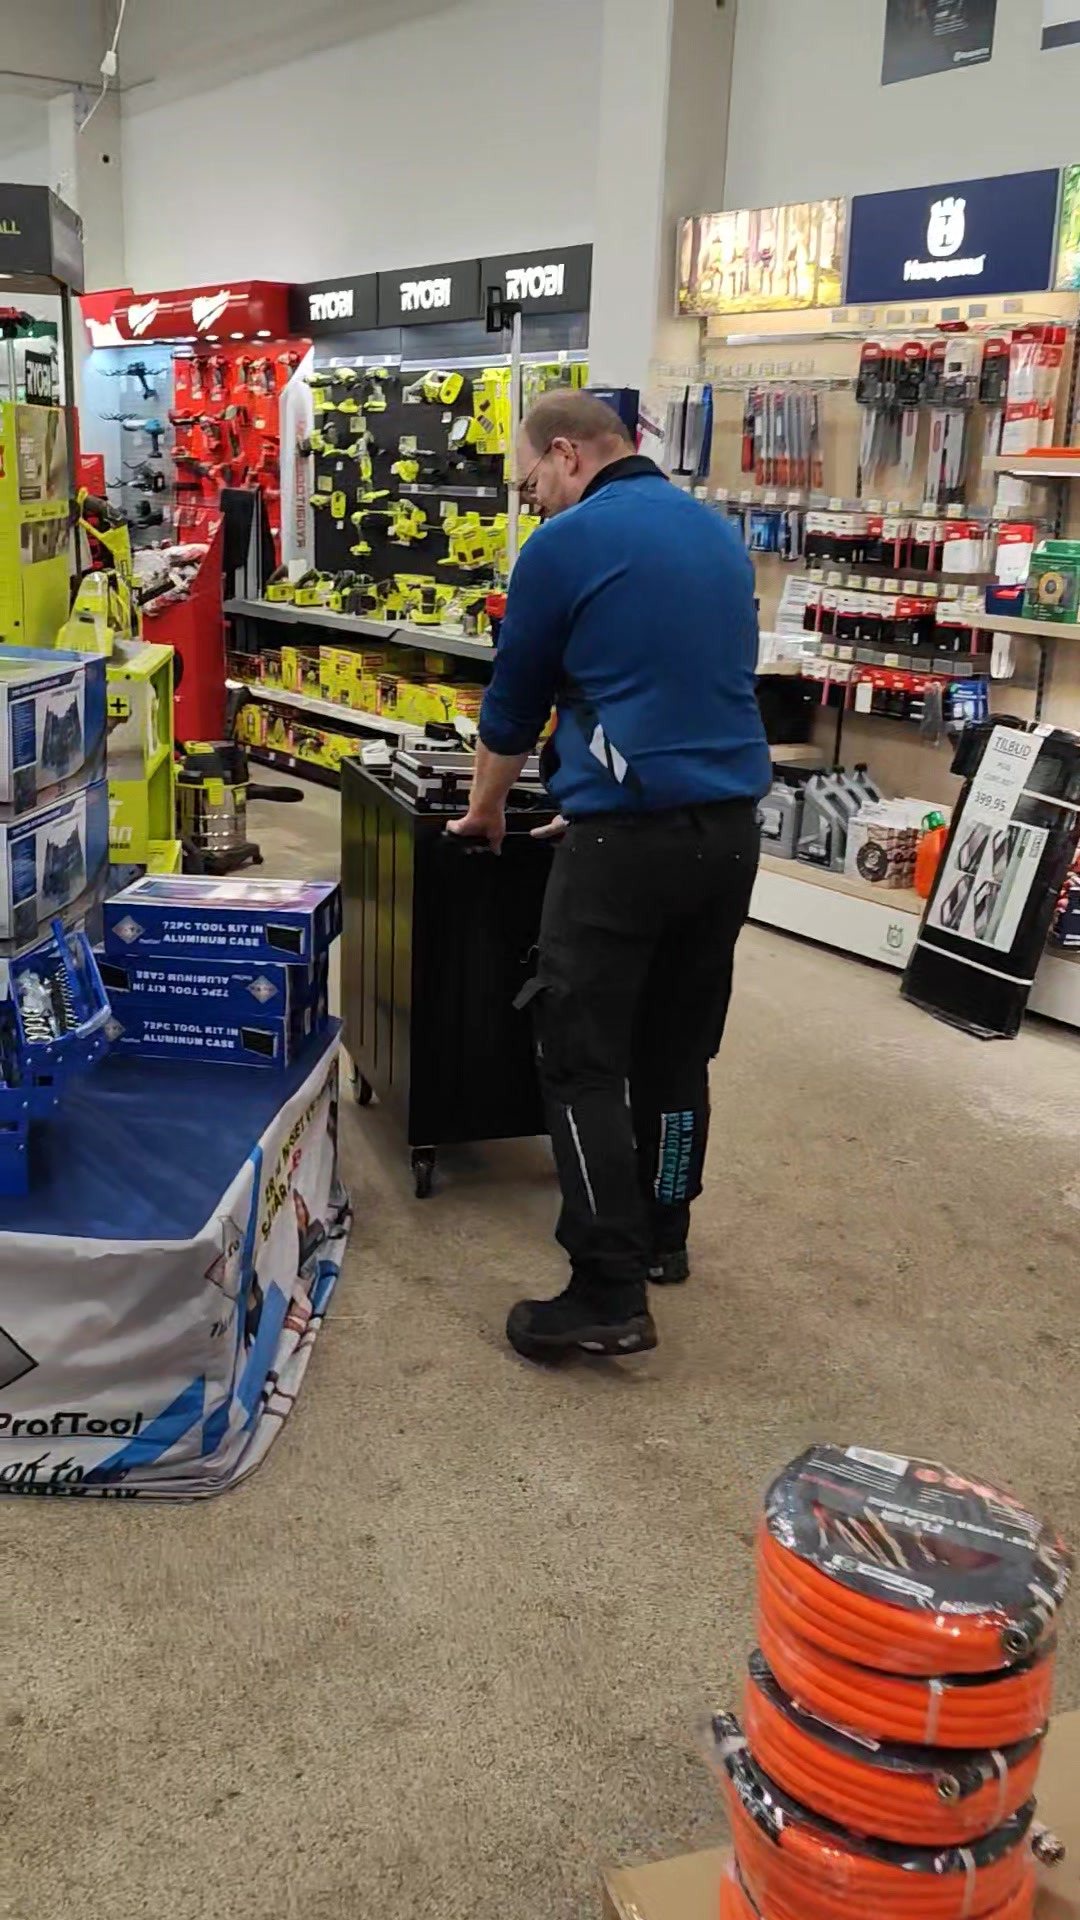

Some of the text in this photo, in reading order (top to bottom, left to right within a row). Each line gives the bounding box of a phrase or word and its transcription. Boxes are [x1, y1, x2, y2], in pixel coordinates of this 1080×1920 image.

[505, 264, 565, 300] RYOBI
[399, 278, 452, 311] RYOBI
[308, 290, 354, 321] RYOBI
[996, 736, 1031, 757] TILBUD
[162, 921, 264, 934] 72PC TOOL KIT IN
[163, 934, 226, 946] ALUMINUM
[229, 936, 260, 947] CASE
[136, 970, 166, 981] CASE
[167, 972, 230, 985] ALUMINUM
[132, 983, 230, 998] 72PC TOOL KIT IN
[143, 1021, 239, 1037] 72PC TOOL KIT IN
[143, 1034, 204, 1046] ALUMINUM
[205, 1037, 236, 1049] CASE
